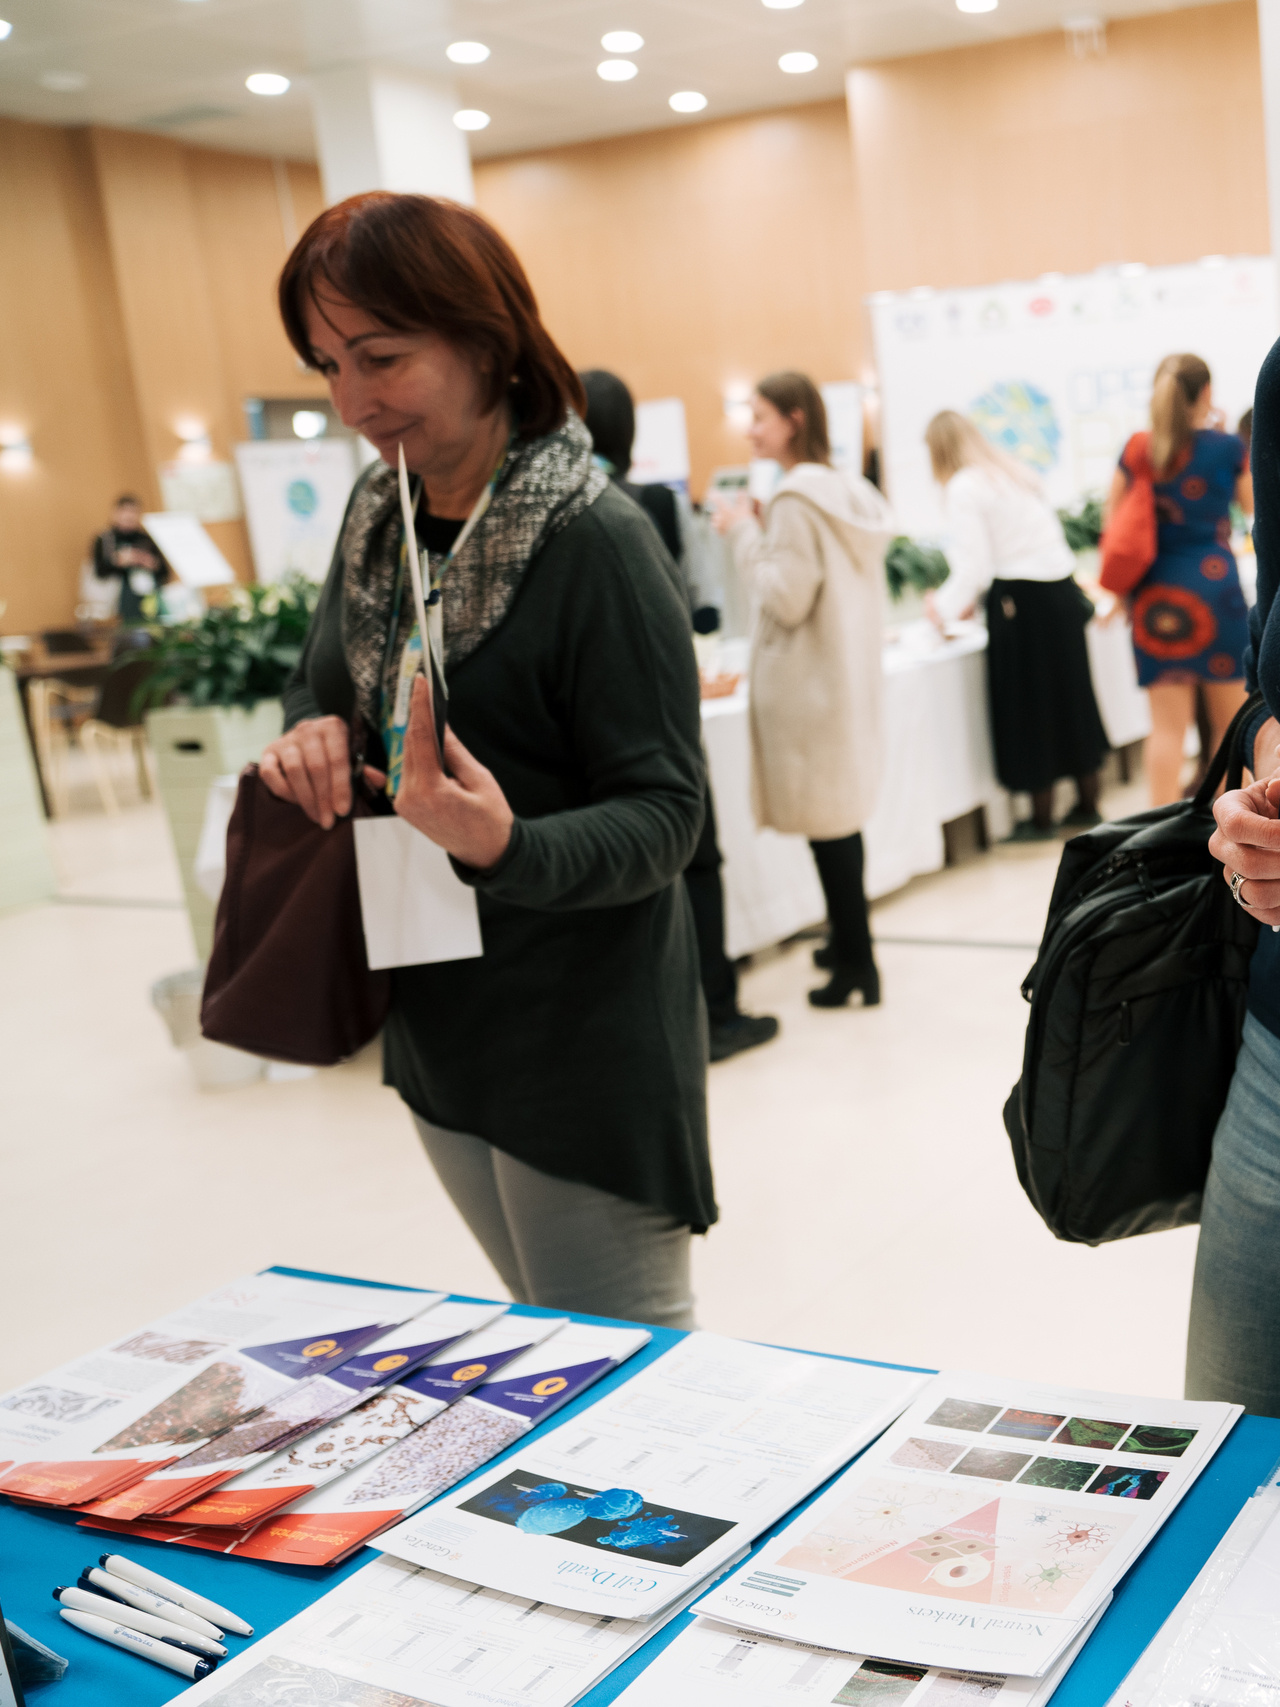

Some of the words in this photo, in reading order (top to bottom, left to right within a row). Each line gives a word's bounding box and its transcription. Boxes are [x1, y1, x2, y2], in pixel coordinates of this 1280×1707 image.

[401, 1535, 452, 1558] GeneTex
[831, 1540, 898, 1575] Neurogenesis
[557, 1560, 615, 1585] Death
[612, 1573, 657, 1592] Cell
[722, 1594, 782, 1617] GeneTex
[906, 1606, 982, 1628] Markers
[982, 1618, 1051, 1636] Neural
